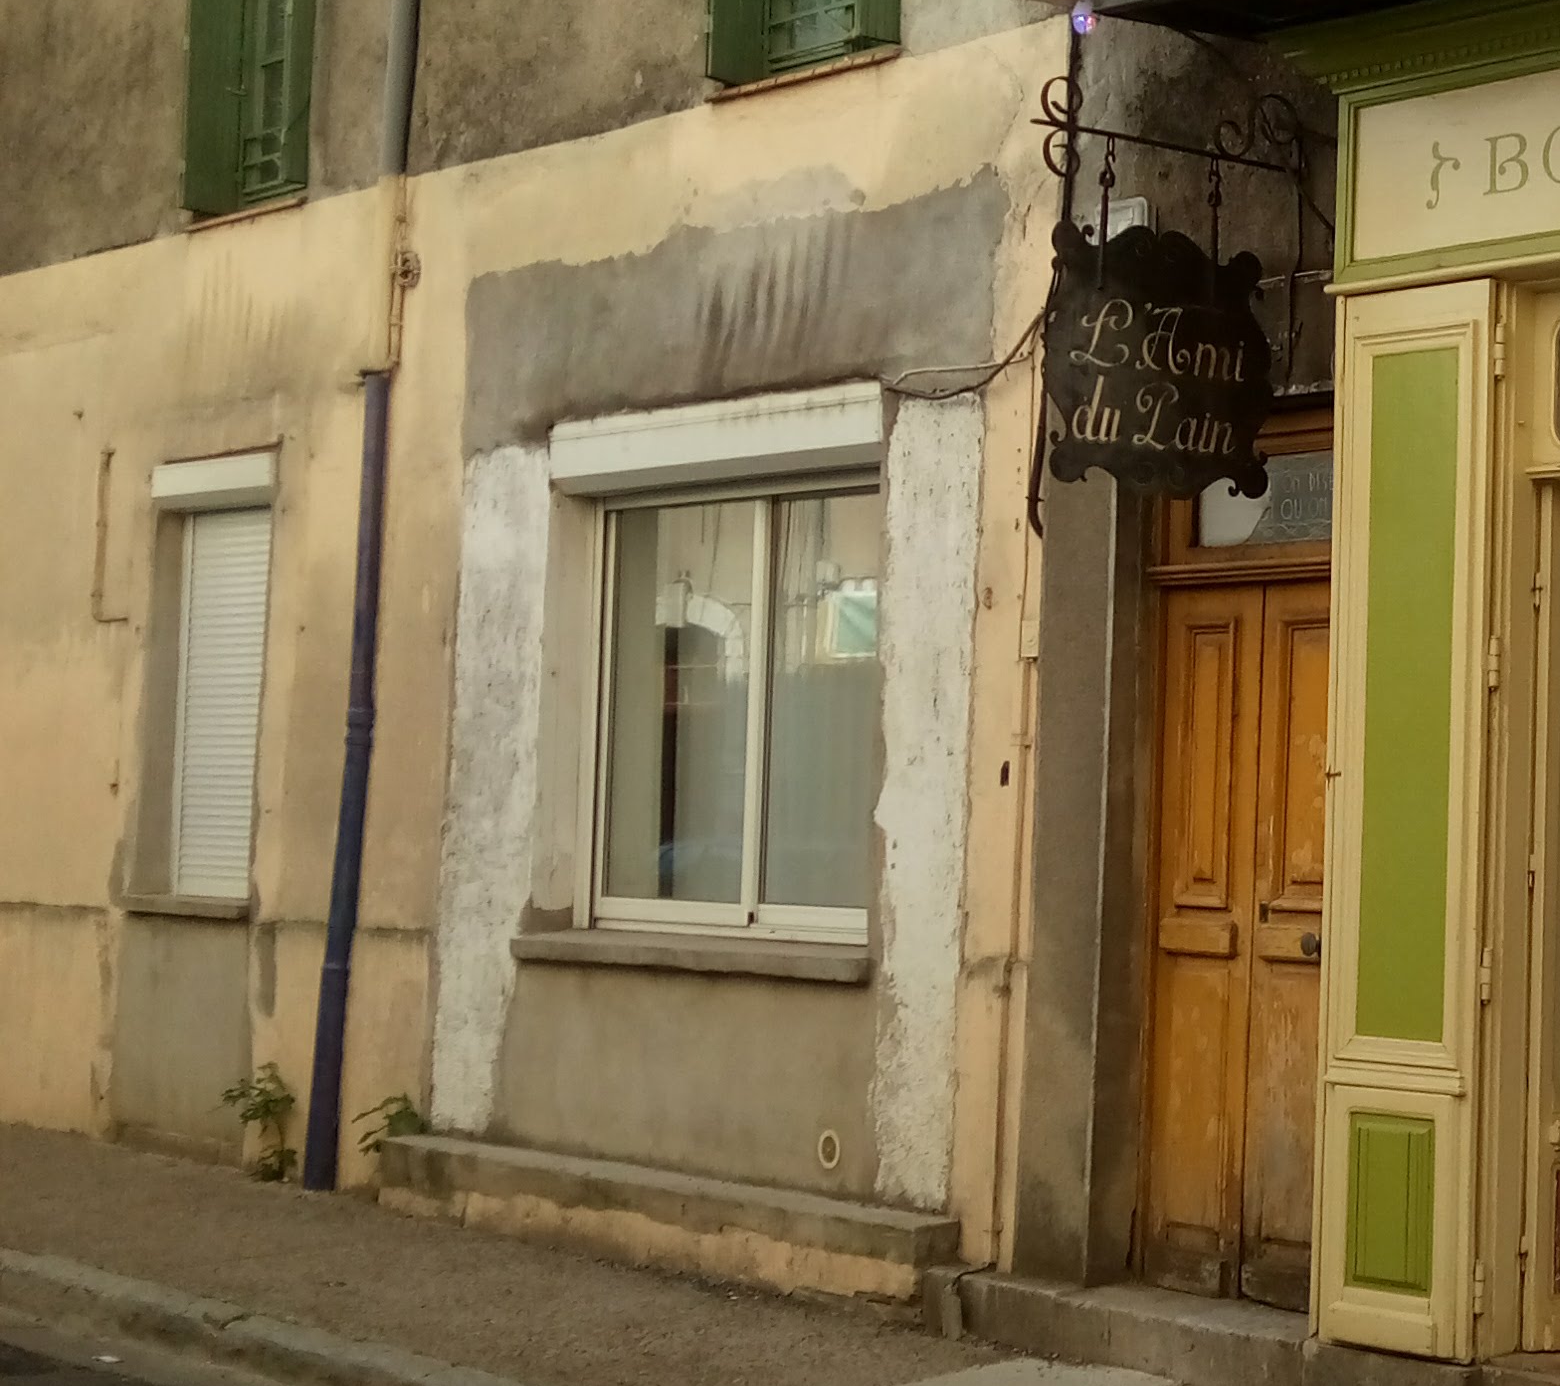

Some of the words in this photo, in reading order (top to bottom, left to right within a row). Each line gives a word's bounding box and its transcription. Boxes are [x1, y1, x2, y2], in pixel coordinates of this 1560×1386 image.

[1069, 298, 1245, 382] L'Ami
[1071, 374, 1121, 443] du
[1131, 381, 1236, 454] Pain
